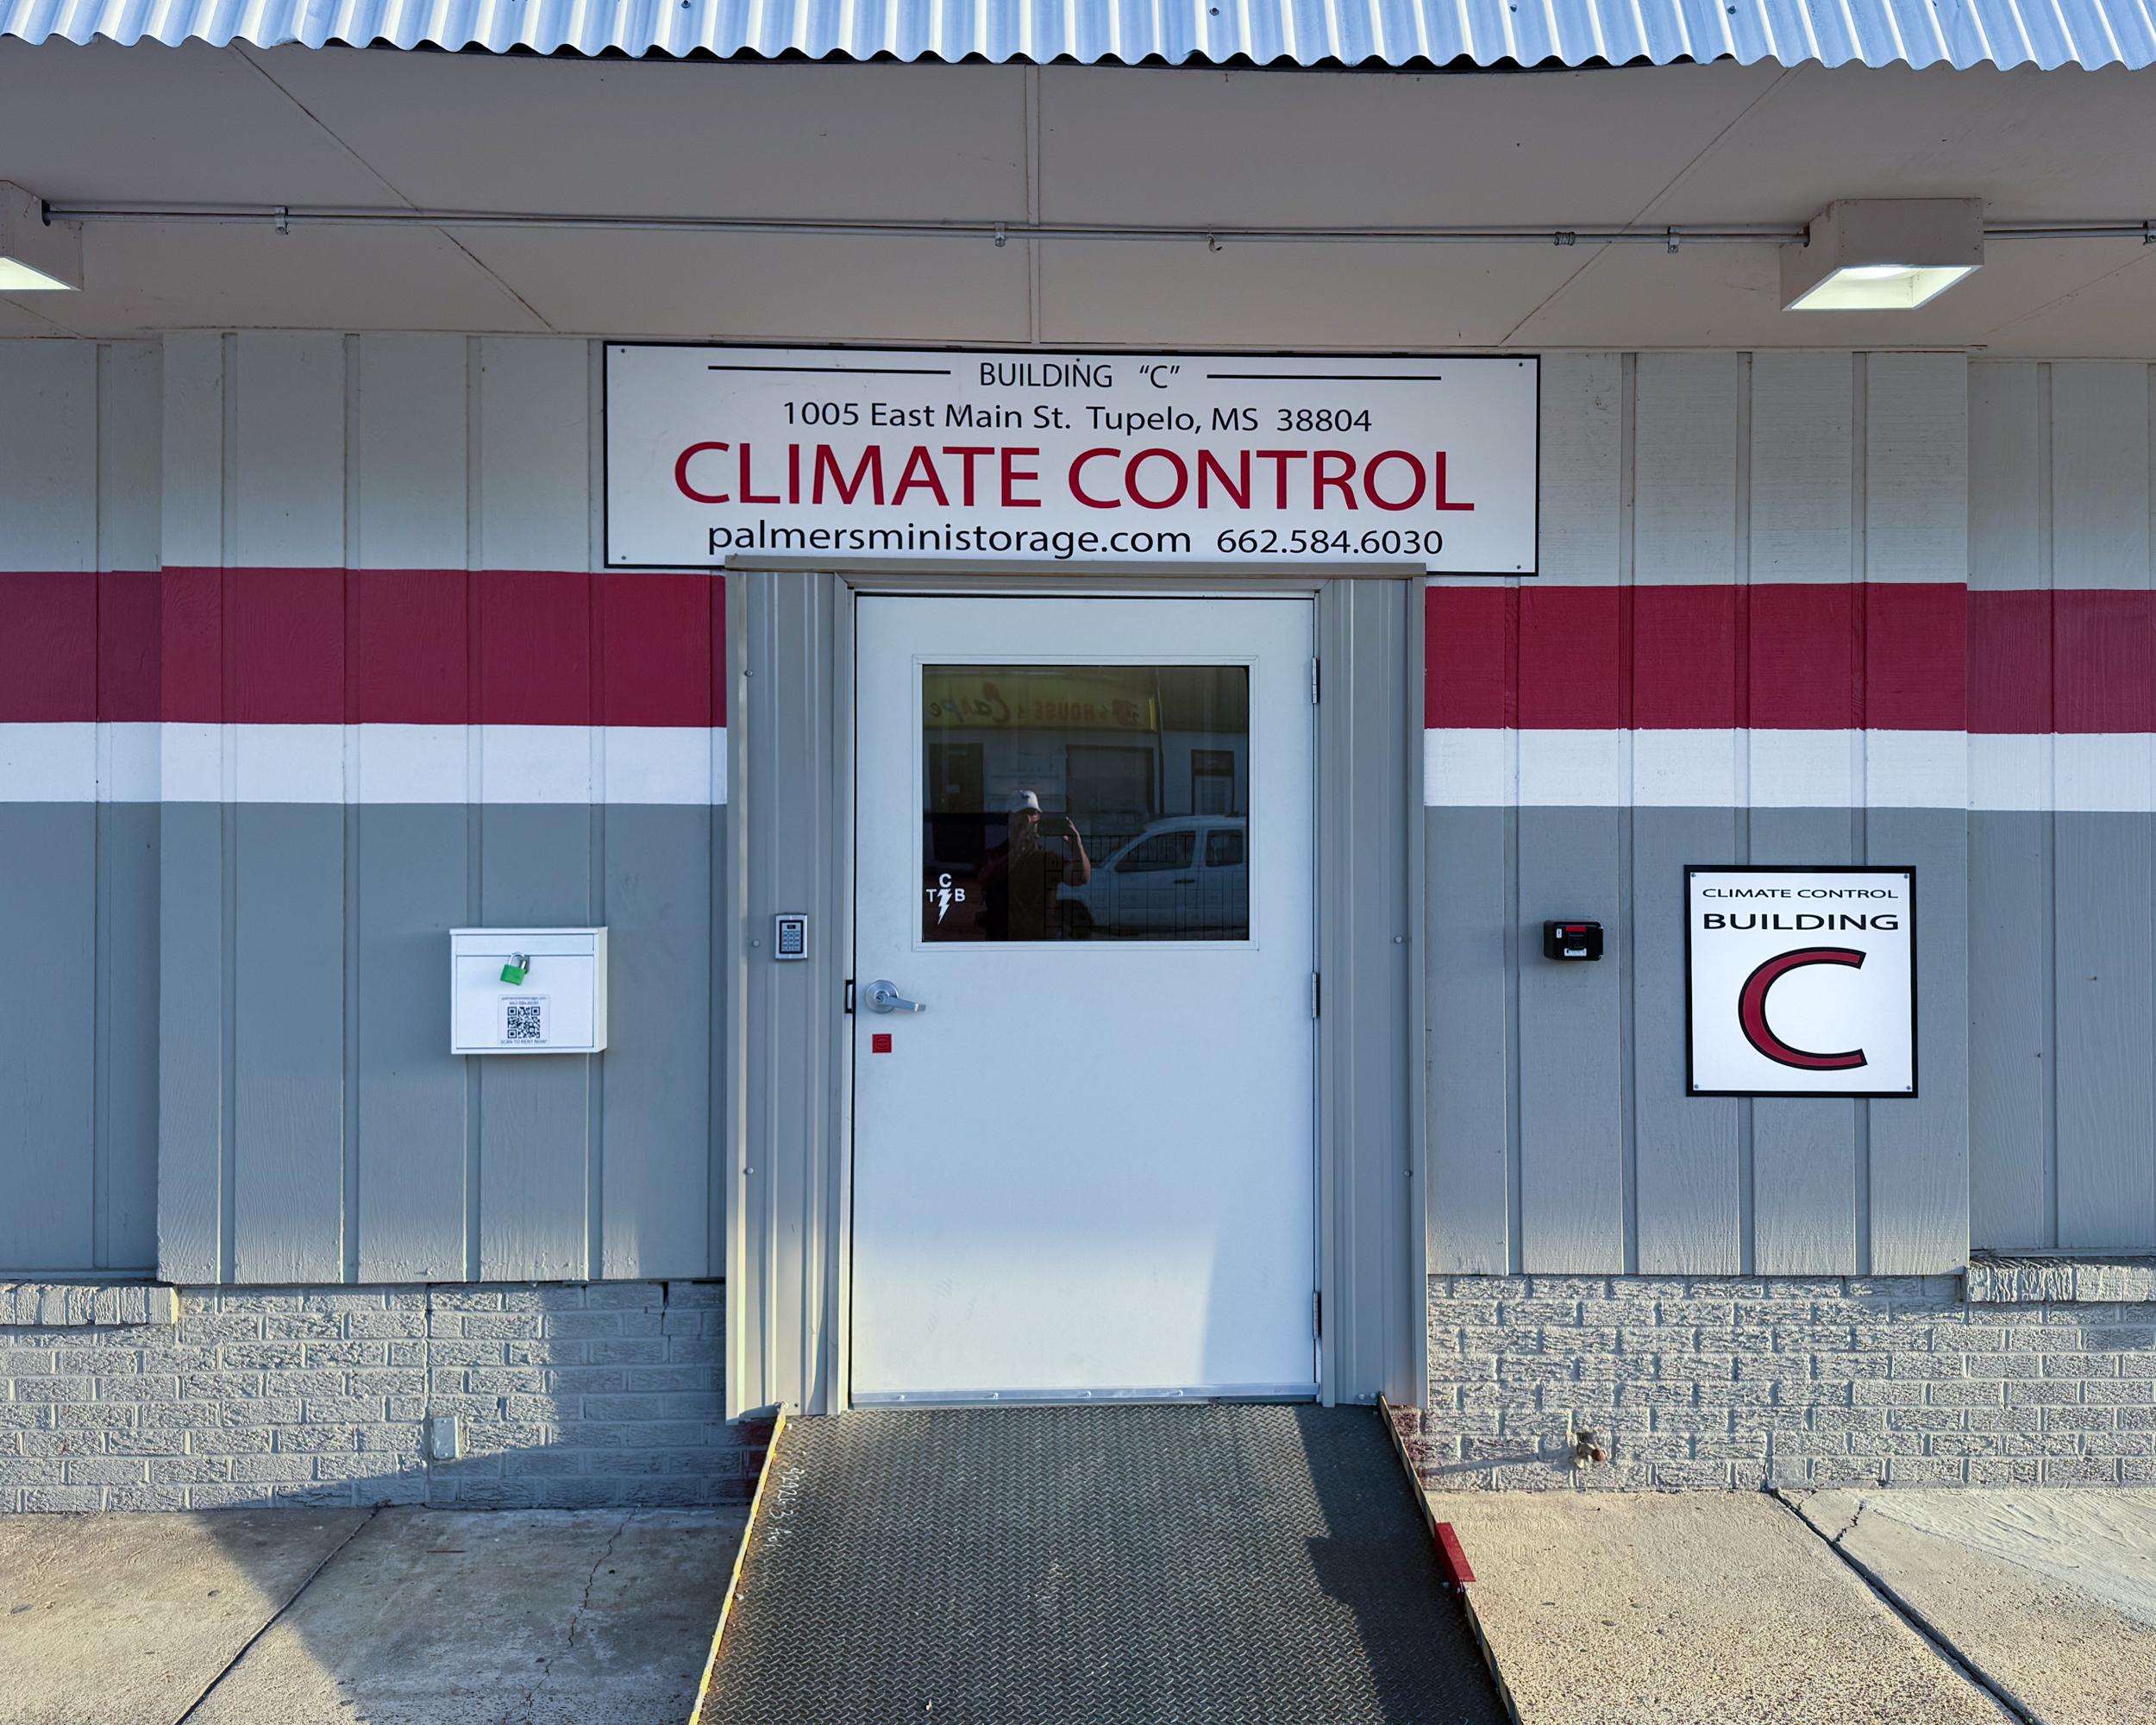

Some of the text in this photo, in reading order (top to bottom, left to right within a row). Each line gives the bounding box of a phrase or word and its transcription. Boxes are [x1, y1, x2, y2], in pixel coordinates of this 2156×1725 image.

[980, 362, 1112, 388] BUILDING
[784, 401, 1372, 436] 1005 East Main St. Tupelo, MS 38804
[674, 441, 1475, 511] CLIMATE CONTROL
[708, 519, 1443, 559] palmersministorage.com 662.584.6030
[1702, 888, 1899, 899] CLIMATE CONTROL
[1703, 913, 1899, 931] BUILDING
[1738, 946, 1868, 1071] C
